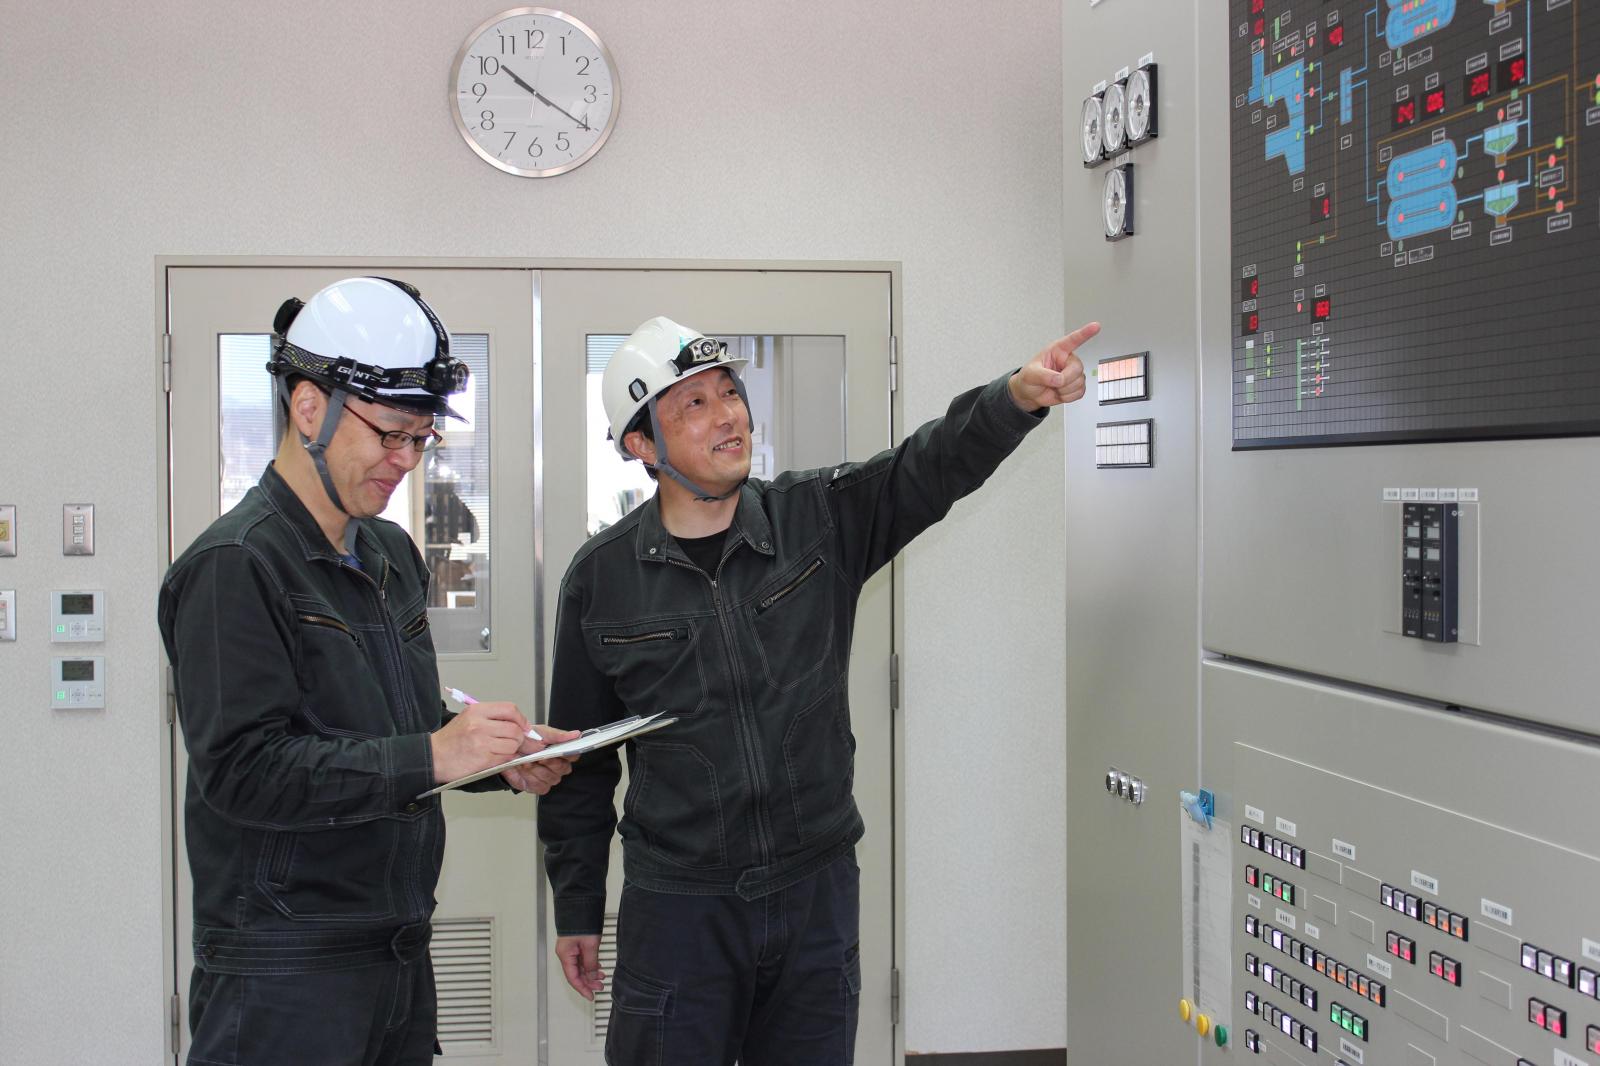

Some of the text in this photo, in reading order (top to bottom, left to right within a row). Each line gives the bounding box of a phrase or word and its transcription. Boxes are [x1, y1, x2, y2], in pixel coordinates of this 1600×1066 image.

[499, 35, 515, 55] 11
[524, 29, 544, 49] 12
[560, 36, 565, 56] 1
[478, 56, 499, 75] 10
[575, 56, 590, 76] 2
[472, 82, 487, 104] 9
[583, 84, 597, 104] 3
[480, 110, 495, 130] 8
[576, 113, 590, 132] 4
[503, 131, 517, 151] 7
[528, 137, 543, 157] 6
[555, 131, 570, 151] 5
